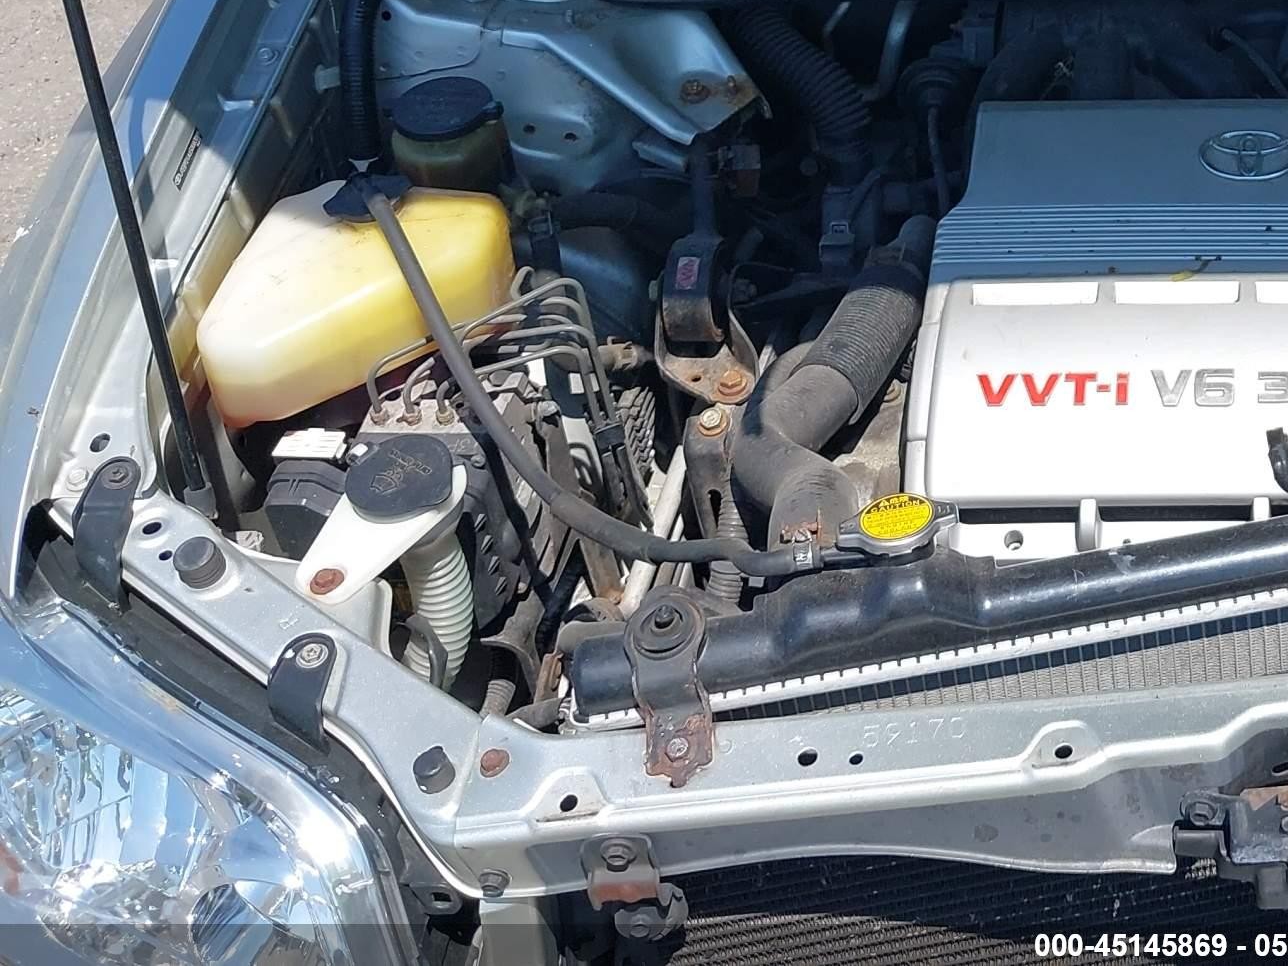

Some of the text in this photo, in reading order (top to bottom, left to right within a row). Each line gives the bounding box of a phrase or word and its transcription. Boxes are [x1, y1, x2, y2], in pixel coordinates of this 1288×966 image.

[975, 371, 1131, 407] VVT-i
[1151, 368, 1235, 407] V6
[870, 499, 920, 513] CAUTION
